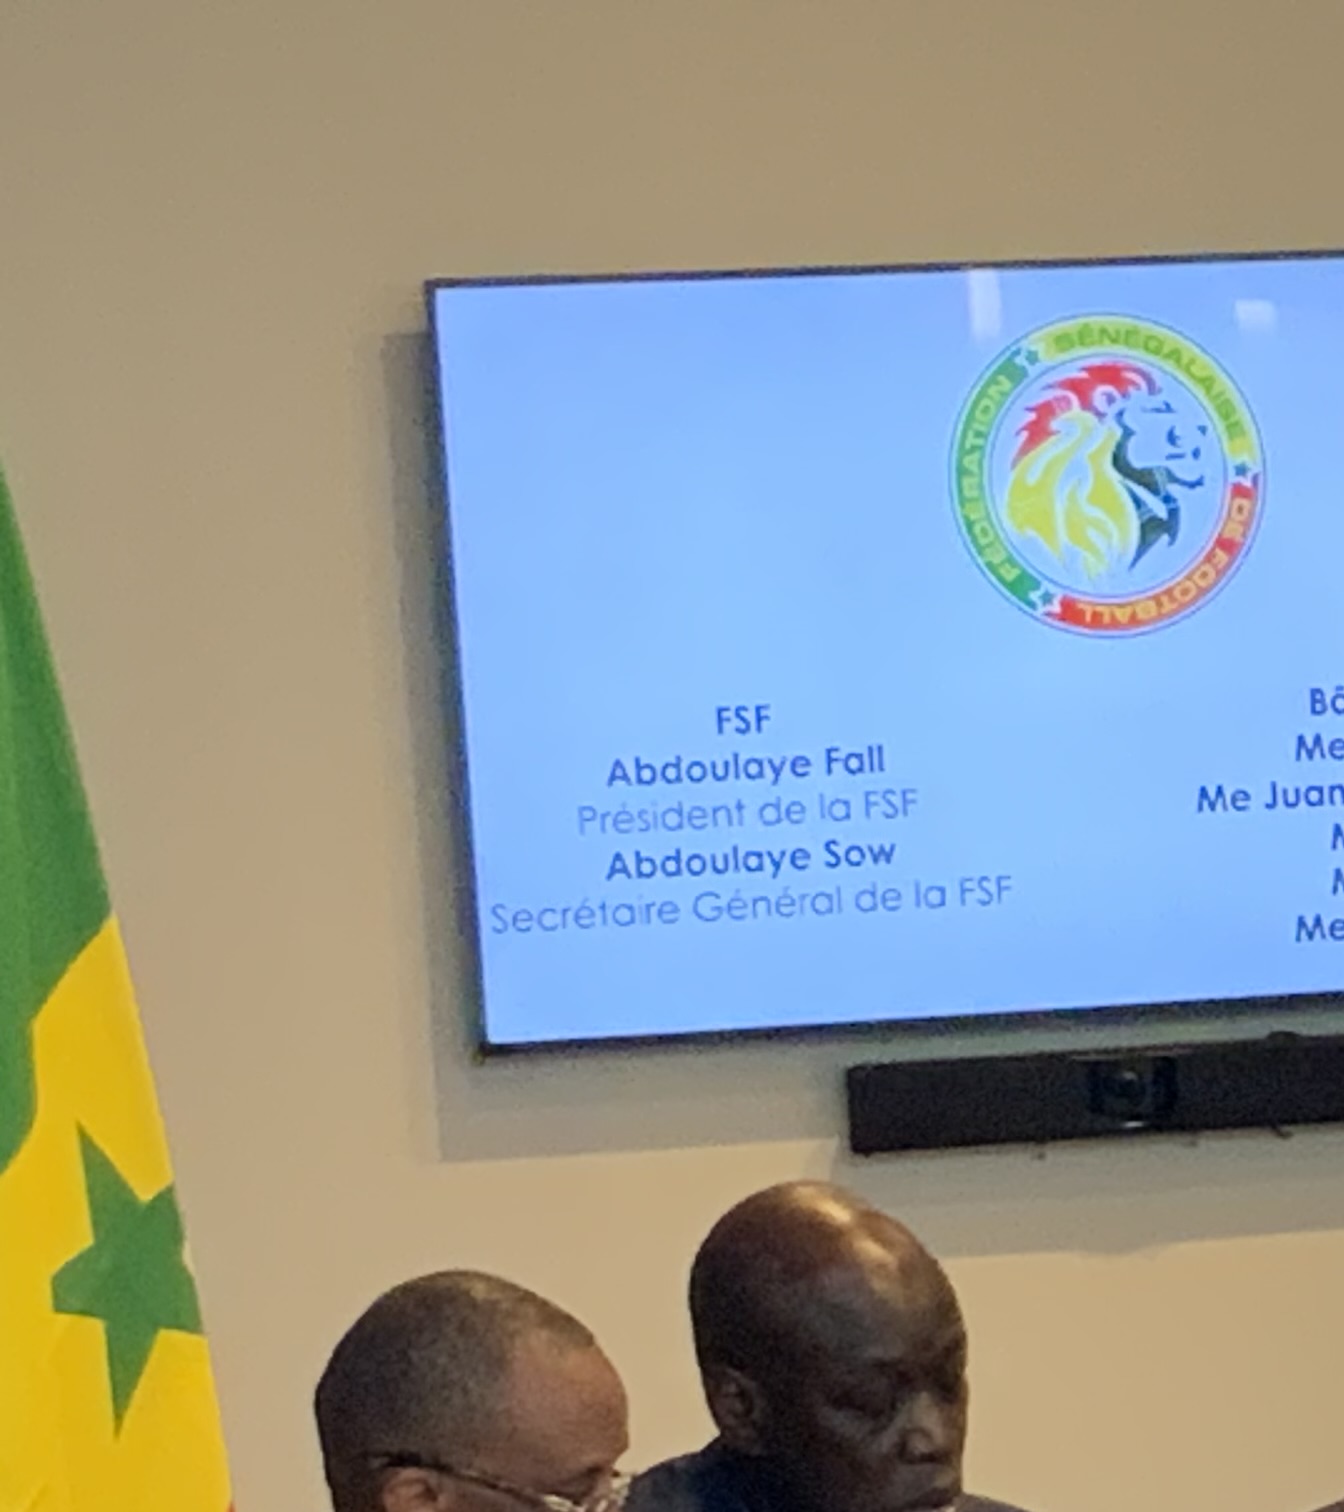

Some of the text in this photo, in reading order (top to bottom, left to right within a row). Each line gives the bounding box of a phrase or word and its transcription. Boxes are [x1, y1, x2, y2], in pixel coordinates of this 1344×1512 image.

[961, 323, 1251, 625] FÉDÉRATION SÉNÉGALAISE DE FOOTBALL
[716, 705, 770, 735] FSF
[607, 745, 884, 787] Abdoulaye Fall
[577, 788, 917, 835] Président de la FSF
[1198, 785, 1251, 813] Me
[606, 840, 895, 881] Abdoulaye Sow
[490, 875, 1011, 934] Secrétaire Général de la FSF
